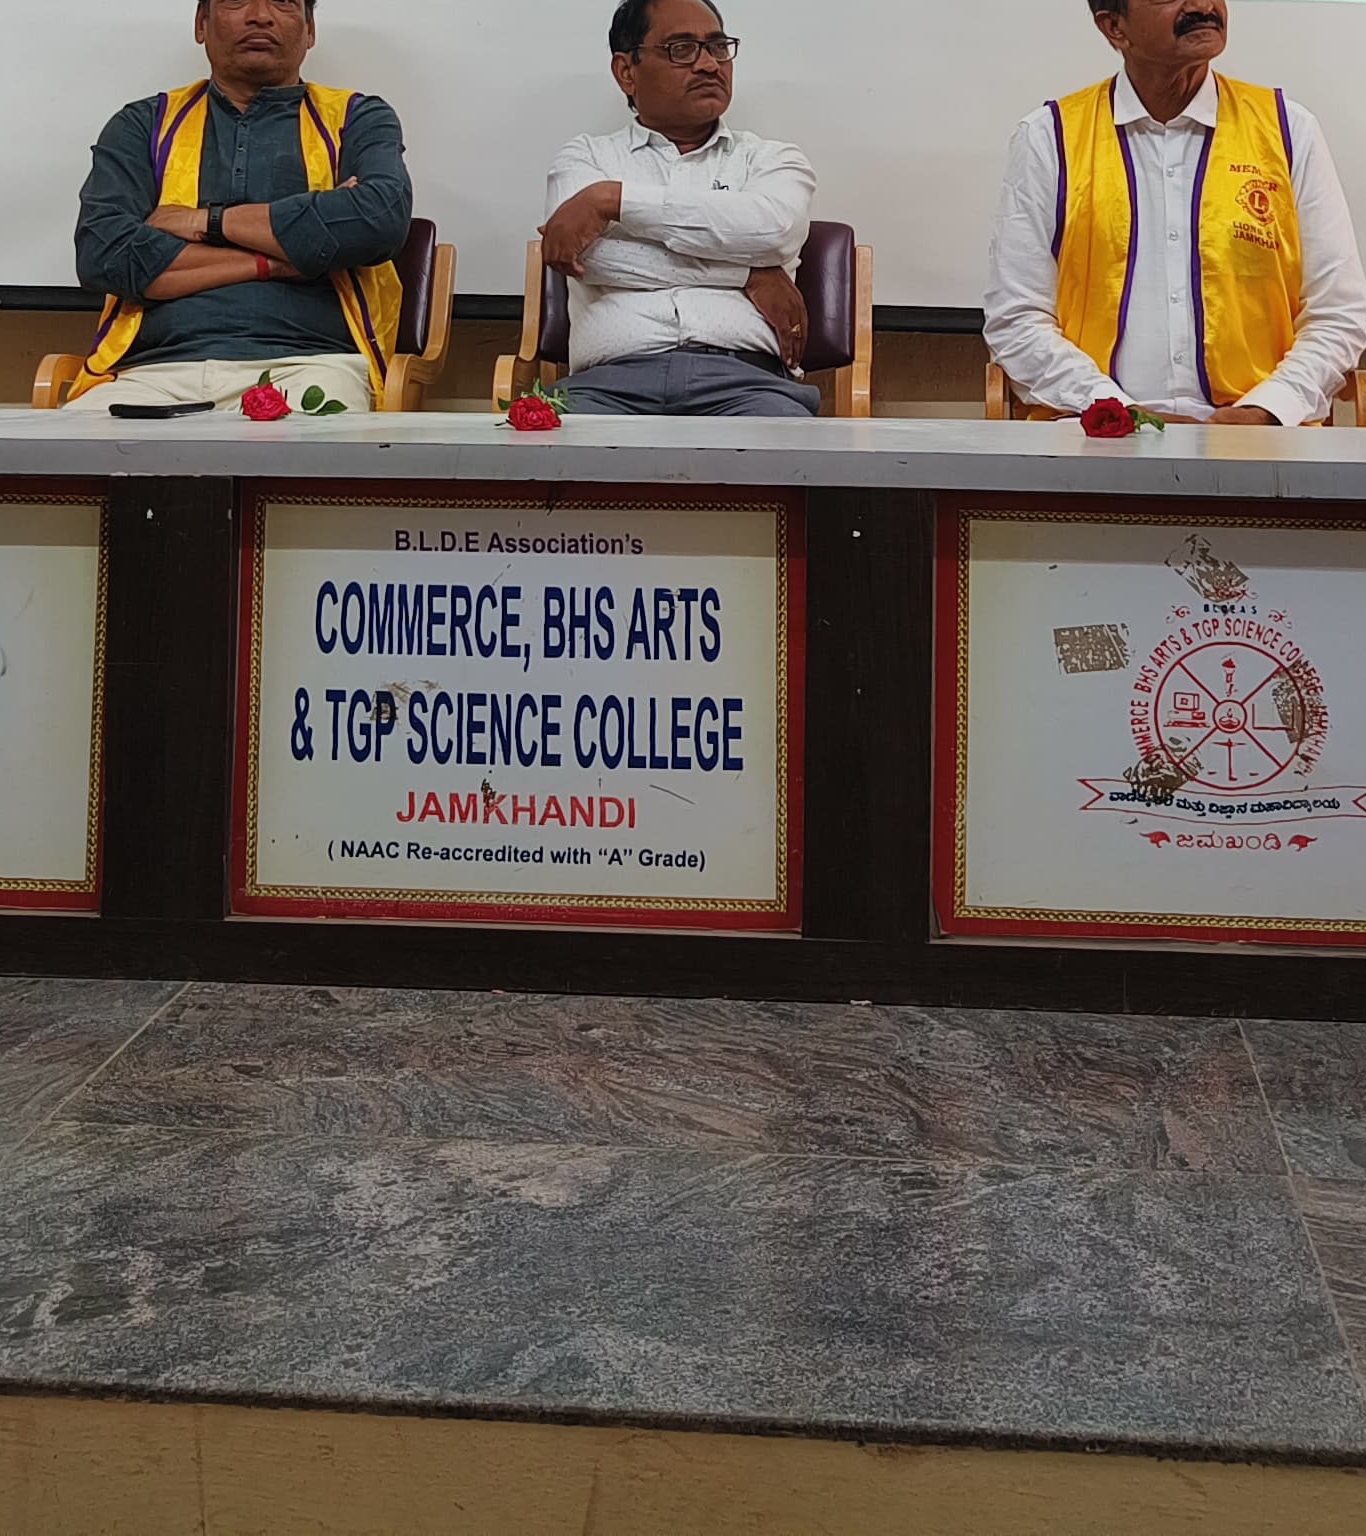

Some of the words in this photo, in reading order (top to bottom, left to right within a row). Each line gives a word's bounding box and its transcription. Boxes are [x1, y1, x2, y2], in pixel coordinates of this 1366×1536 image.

[394, 529, 480, 554] B.L.D.E
[487, 531, 644, 556] Association's
[315, 580, 532, 672] COMMERCE,
[542, 585, 616, 661] BHS
[625, 586, 722, 663] ARTS
[1134, 664, 1159, 694] BHS
[1149, 634, 1183, 668] ARTS
[1192, 618, 1220, 640] TGP
[1224, 618, 1283, 650] SCIENCE
[290, 687, 314, 762] &
[324, 688, 397, 763] TGP
[406, 691, 562, 767] SCIENCE
[573, 694, 745, 771] COLLEGE
[395, 790, 636, 829] JAMKHANDI
[340, 840, 400, 859] NAAC
[406, 842, 544, 865] Re-accredited
[549, 847, 592, 865] with
[638, 849, 706, 872] Grade)
